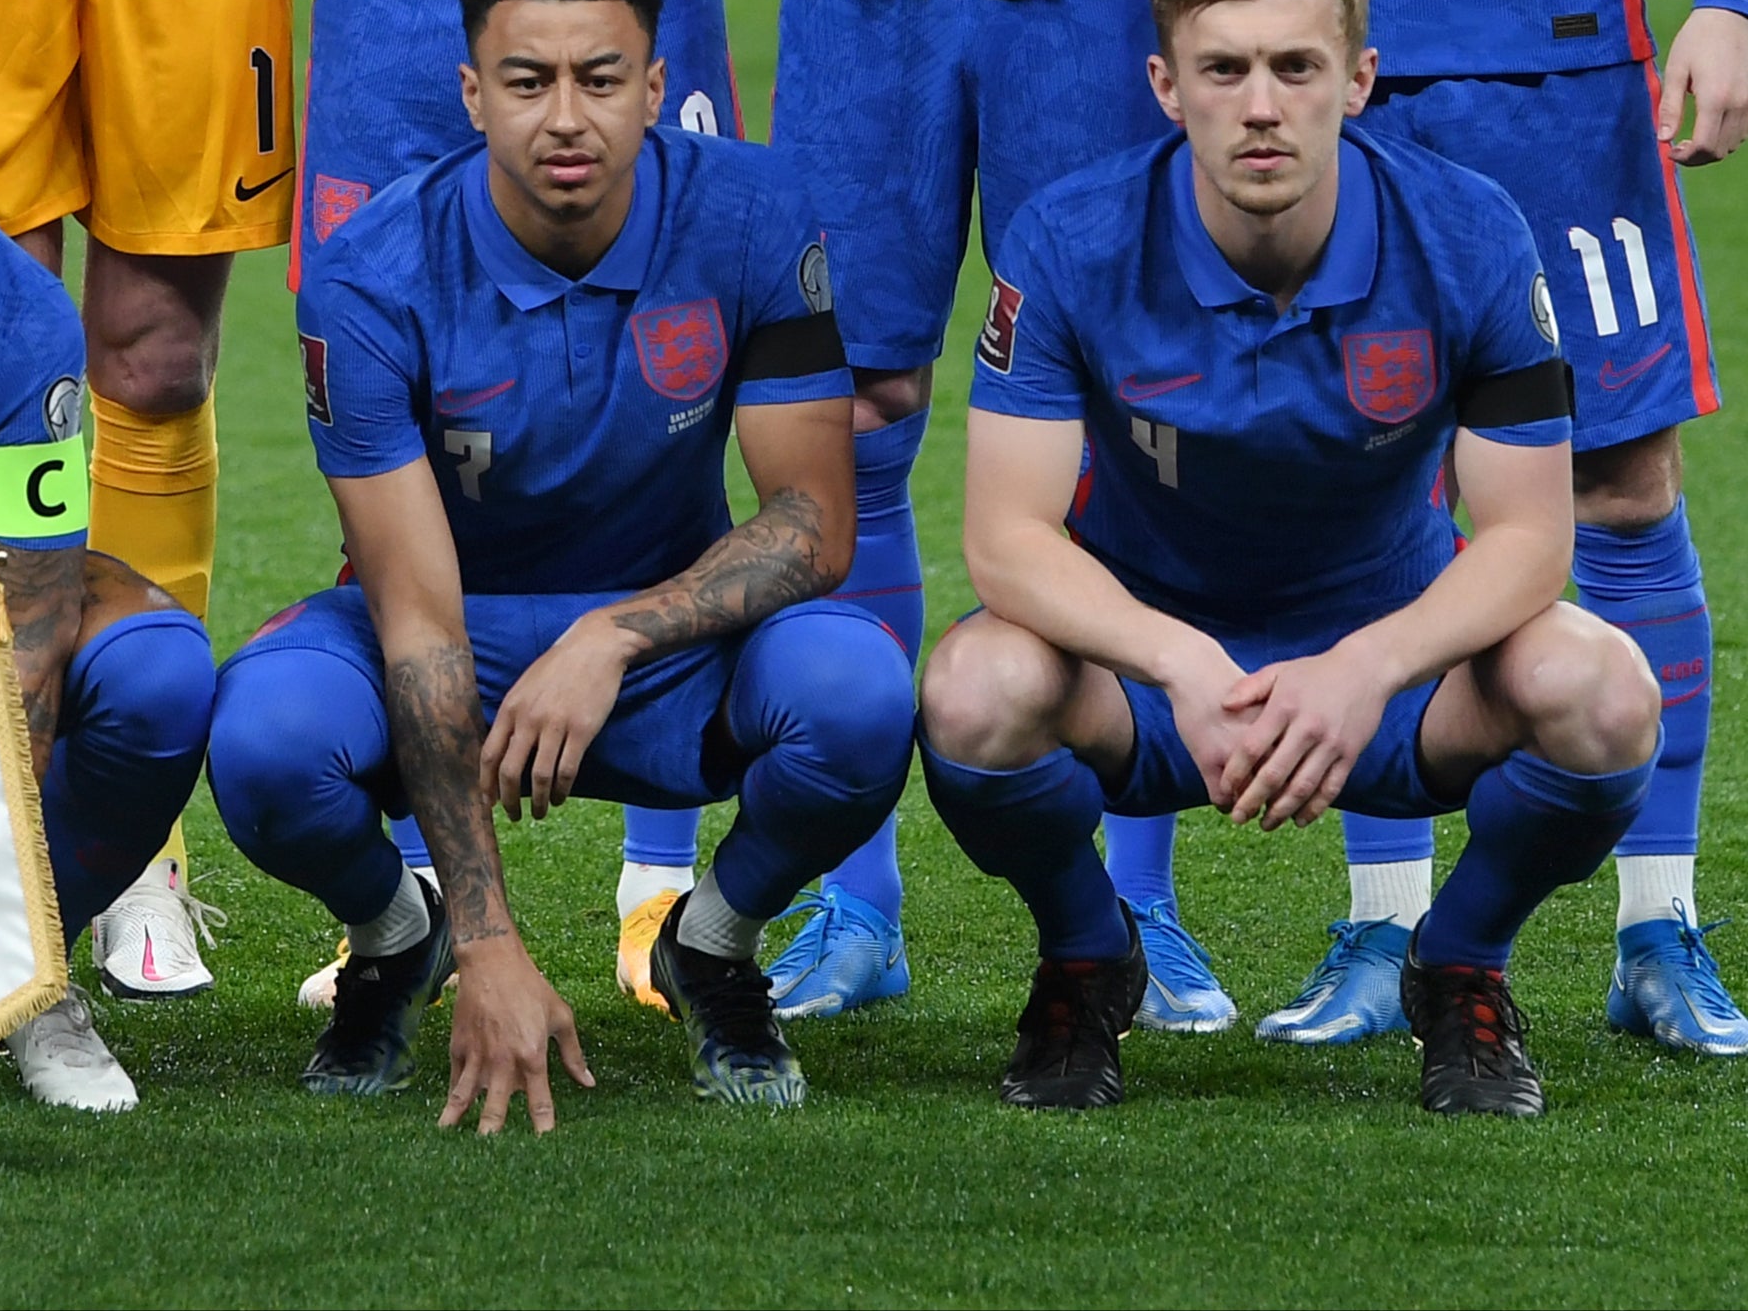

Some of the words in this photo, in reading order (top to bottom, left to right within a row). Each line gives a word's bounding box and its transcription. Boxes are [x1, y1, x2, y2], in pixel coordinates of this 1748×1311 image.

[250, 46, 275, 154] 1
[1568, 217, 1659, 337] 11
[26, 460, 67, 518] C
[444, 430, 492, 502] 7
[1131, 418, 1178, 489] 4
